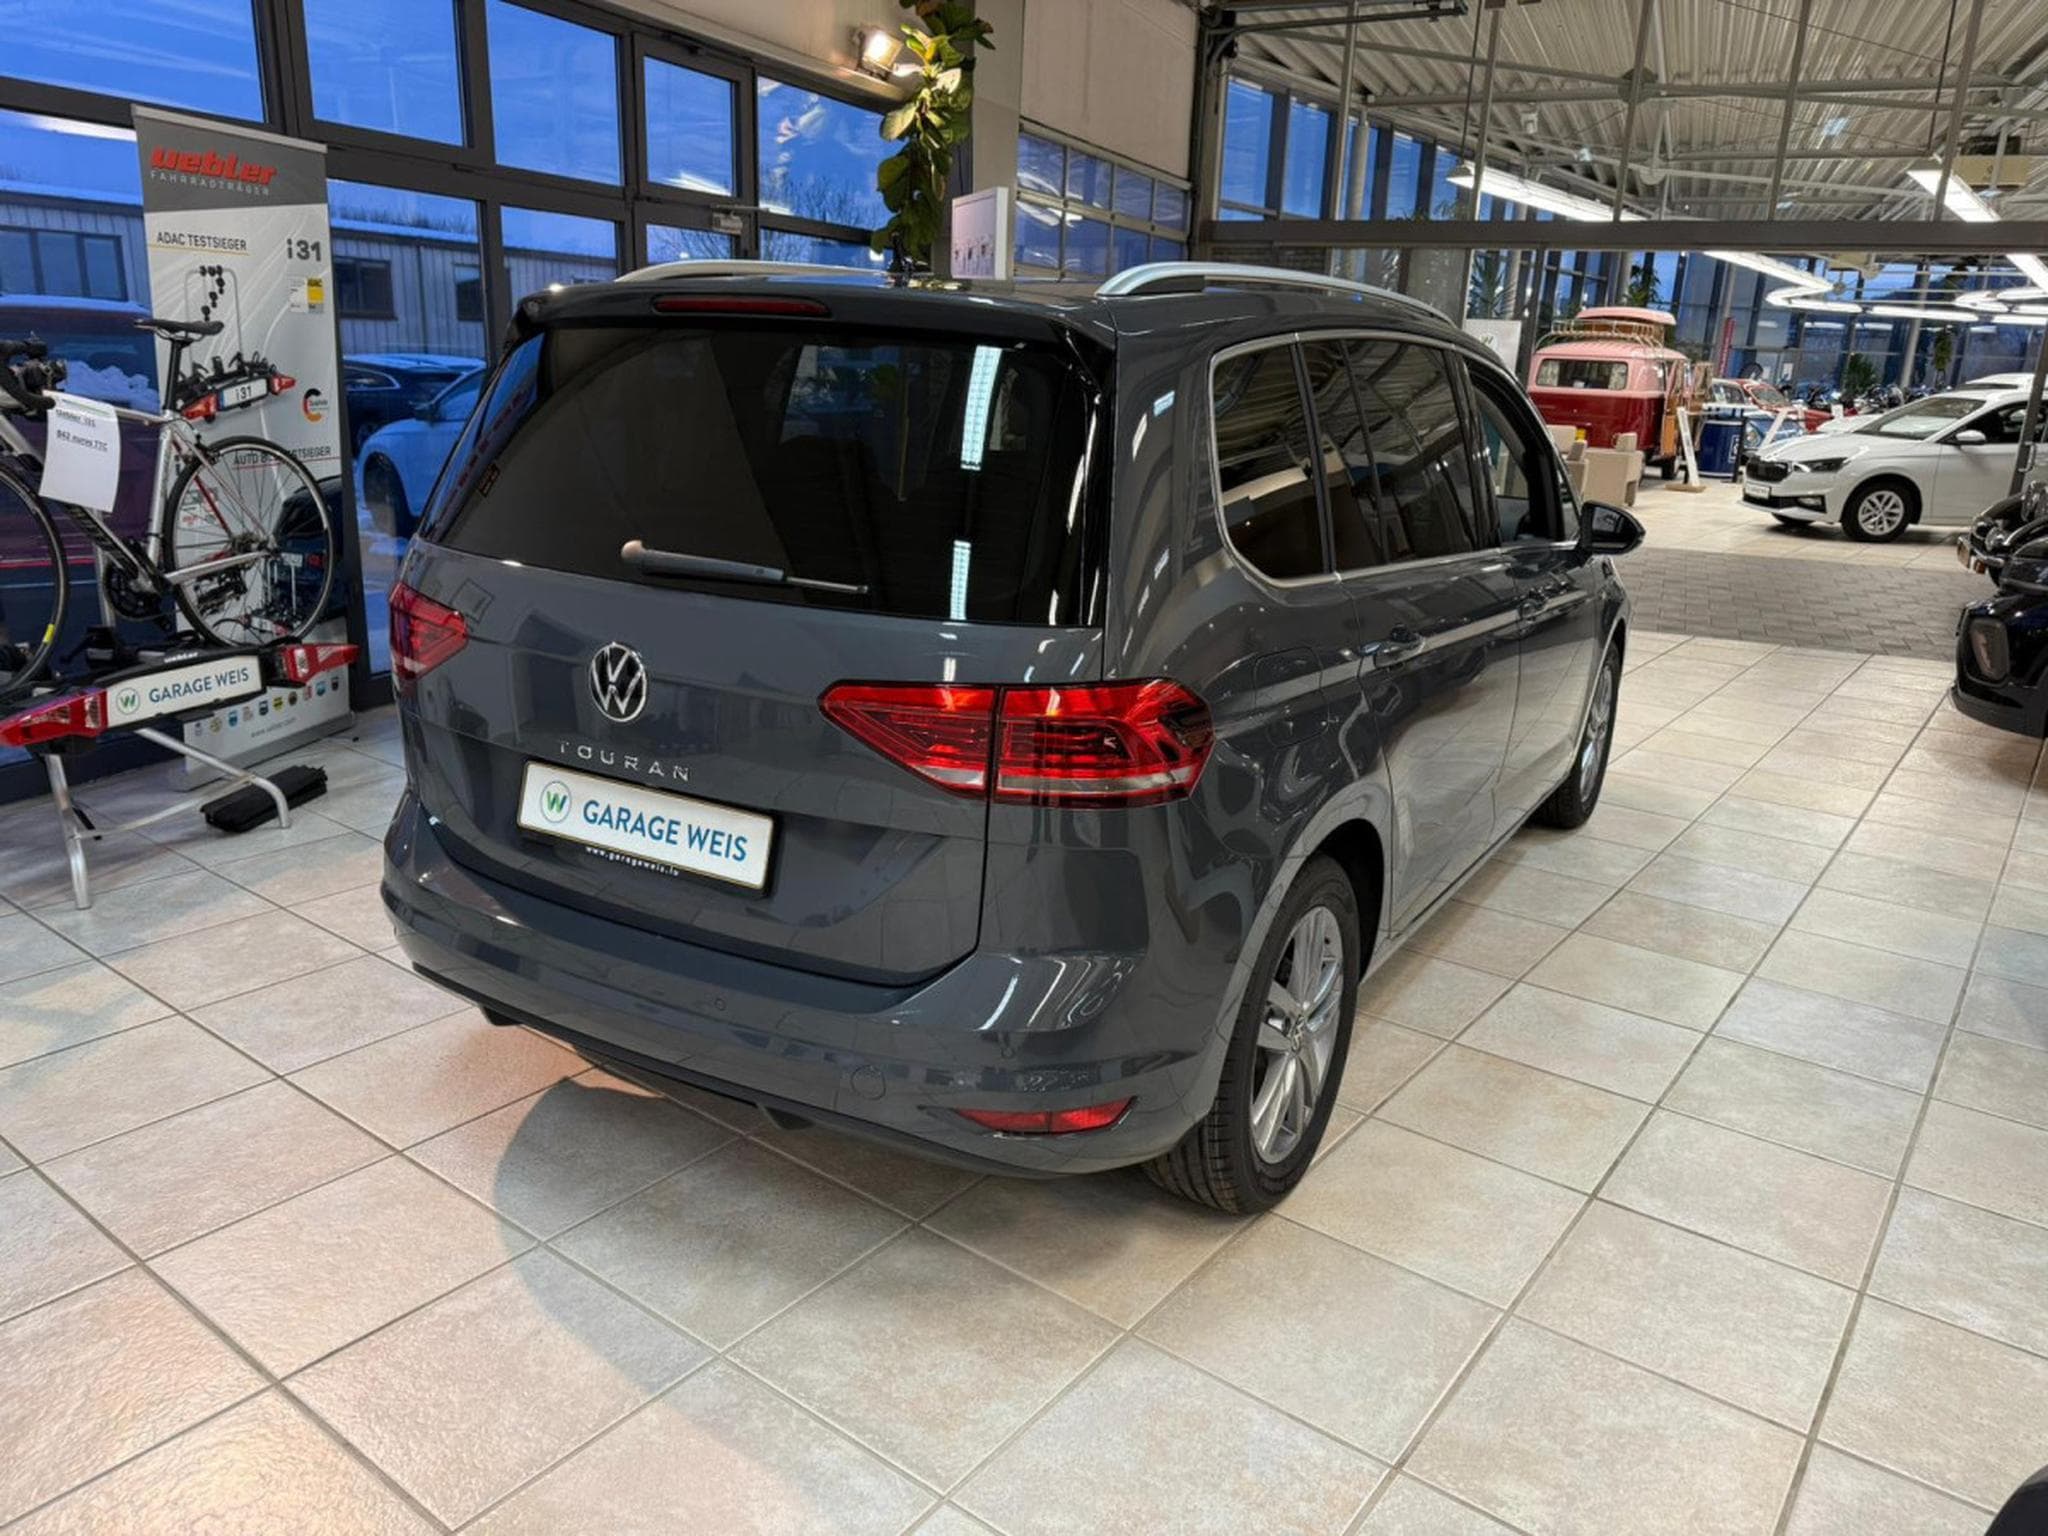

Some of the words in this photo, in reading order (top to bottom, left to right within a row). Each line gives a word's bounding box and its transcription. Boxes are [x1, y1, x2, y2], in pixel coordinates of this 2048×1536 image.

[157, 231, 186, 246] ADAC
[187, 234, 247, 251] TESTSIEGER
[235, 386, 252, 402] i31
[149, 678, 213, 703] GARAGE
[215, 668, 249, 687] WEIS
[560, 741, 690, 782] TOURAN
[583, 799, 682, 845] GARAGE
[687, 824, 749, 863] WEIS
